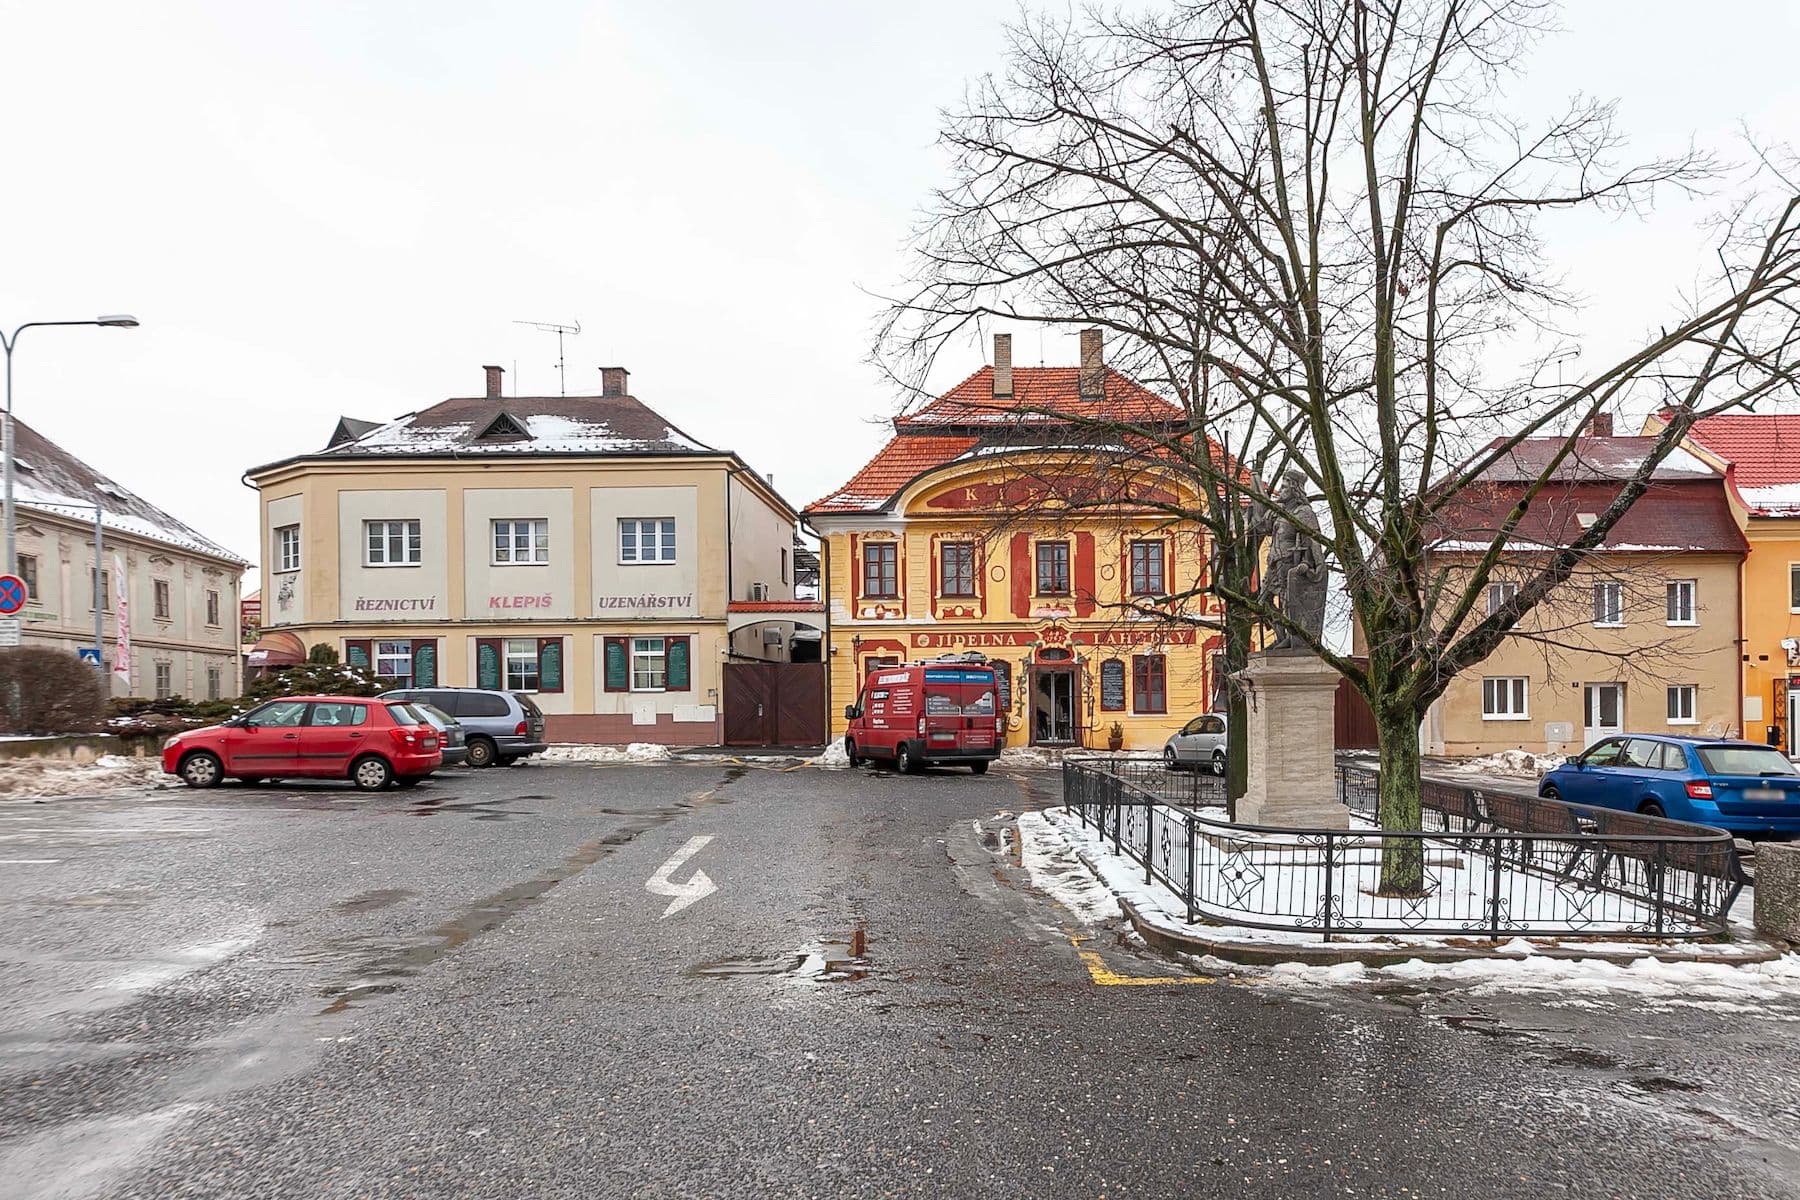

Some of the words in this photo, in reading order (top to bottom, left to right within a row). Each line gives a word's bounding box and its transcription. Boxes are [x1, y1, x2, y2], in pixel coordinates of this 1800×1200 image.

[354, 595, 436, 611] ŘEZNICTVÍ
[488, 592, 553, 609] KLEPIŠ
[598, 592, 693, 609] UZENÁŘSTVÍ
[936, 632, 1017, 648] JÍDELNA
